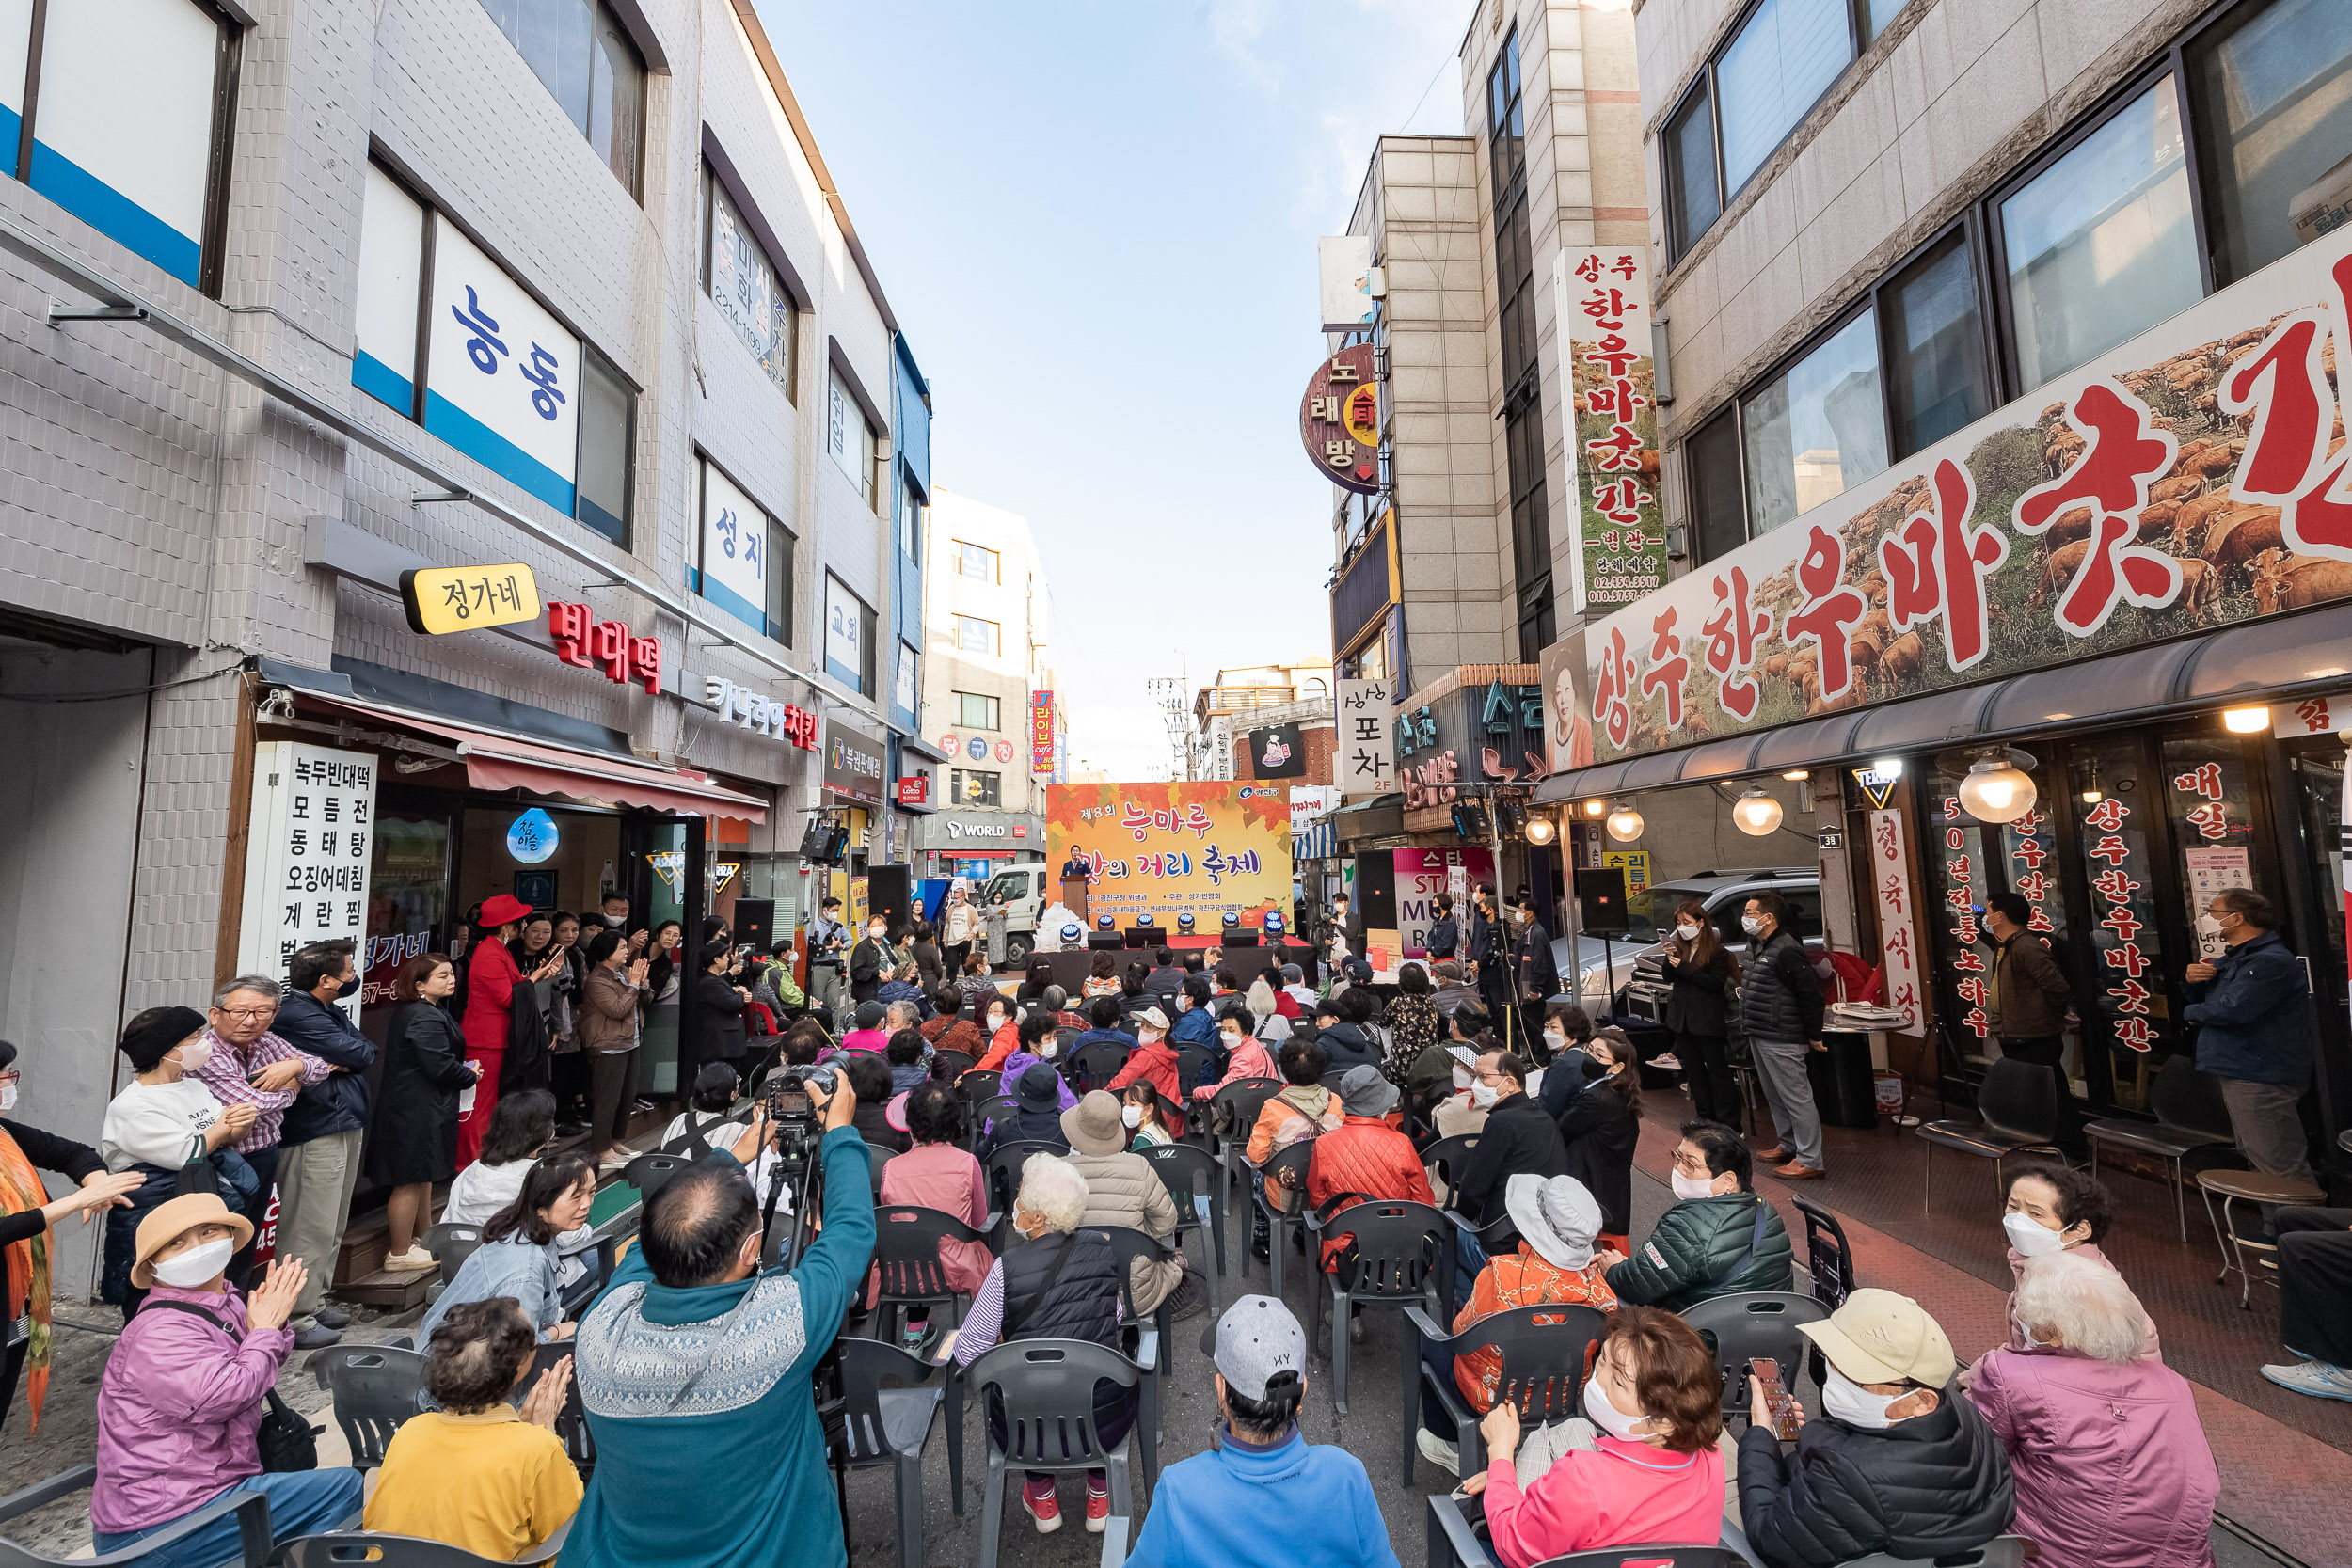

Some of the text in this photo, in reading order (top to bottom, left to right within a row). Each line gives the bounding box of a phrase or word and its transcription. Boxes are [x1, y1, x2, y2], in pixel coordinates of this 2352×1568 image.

[738, 231, 754, 316] 미화
[1575, 254, 1637, 284] 상주
[716, 285, 761, 356] 2214-1199
[452, 284, 566, 421] 능동
[1311, 357, 1359, 468] 노래방
[1352, 388, 1375, 429] 스타
[1580, 288, 1650, 524] 한우마굿간
[715, 508, 762, 580] 성지
[442, 575, 521, 620] 정가네
[1595, 576, 1659, 588] 02.454.3517
[832, 605, 857, 651] 교회
[548, 601, 662, 695] 빈대떡
[707, 675, 787, 741] 카나리아
[1036, 693, 1051, 706] J
[1345, 683, 1386, 709] 상상
[785, 705, 818, 752] 치킨
[1036, 707, 1051, 744] 라이브
[846, 746, 881, 779] 복권판매점
[943, 737, 1012, 762] 당구장
[1034, 745, 1052, 756] cafe
[1352, 717, 1390, 778] 포차
[295, 757, 370, 791] 녹두빈대떡
[1375, 781, 1391, 791] 2F
[293, 795, 368, 824] 모듬전
[1254, 788, 1279, 797] 광진구
[1081, 804, 1117, 820] 제8회
[1121, 801, 1213, 842] 능마루
[290, 829, 365, 858] 동태탕
[964, 825, 1005, 837] WORLD
[1825, 836, 1836, 845] 38
[715, 864, 734, 877] RRA
[1136, 849, 1193, 879] 거리
[1201, 843, 1261, 886] 축제
[1422, 850, 1463, 868] 스타
[286, 865, 364, 893] 오징어데침
[283, 900, 361, 929] 계란찜
[1876, 819, 1920, 1025] 정육식당
[2085, 799, 2159, 1052] 상주한우마굿간
